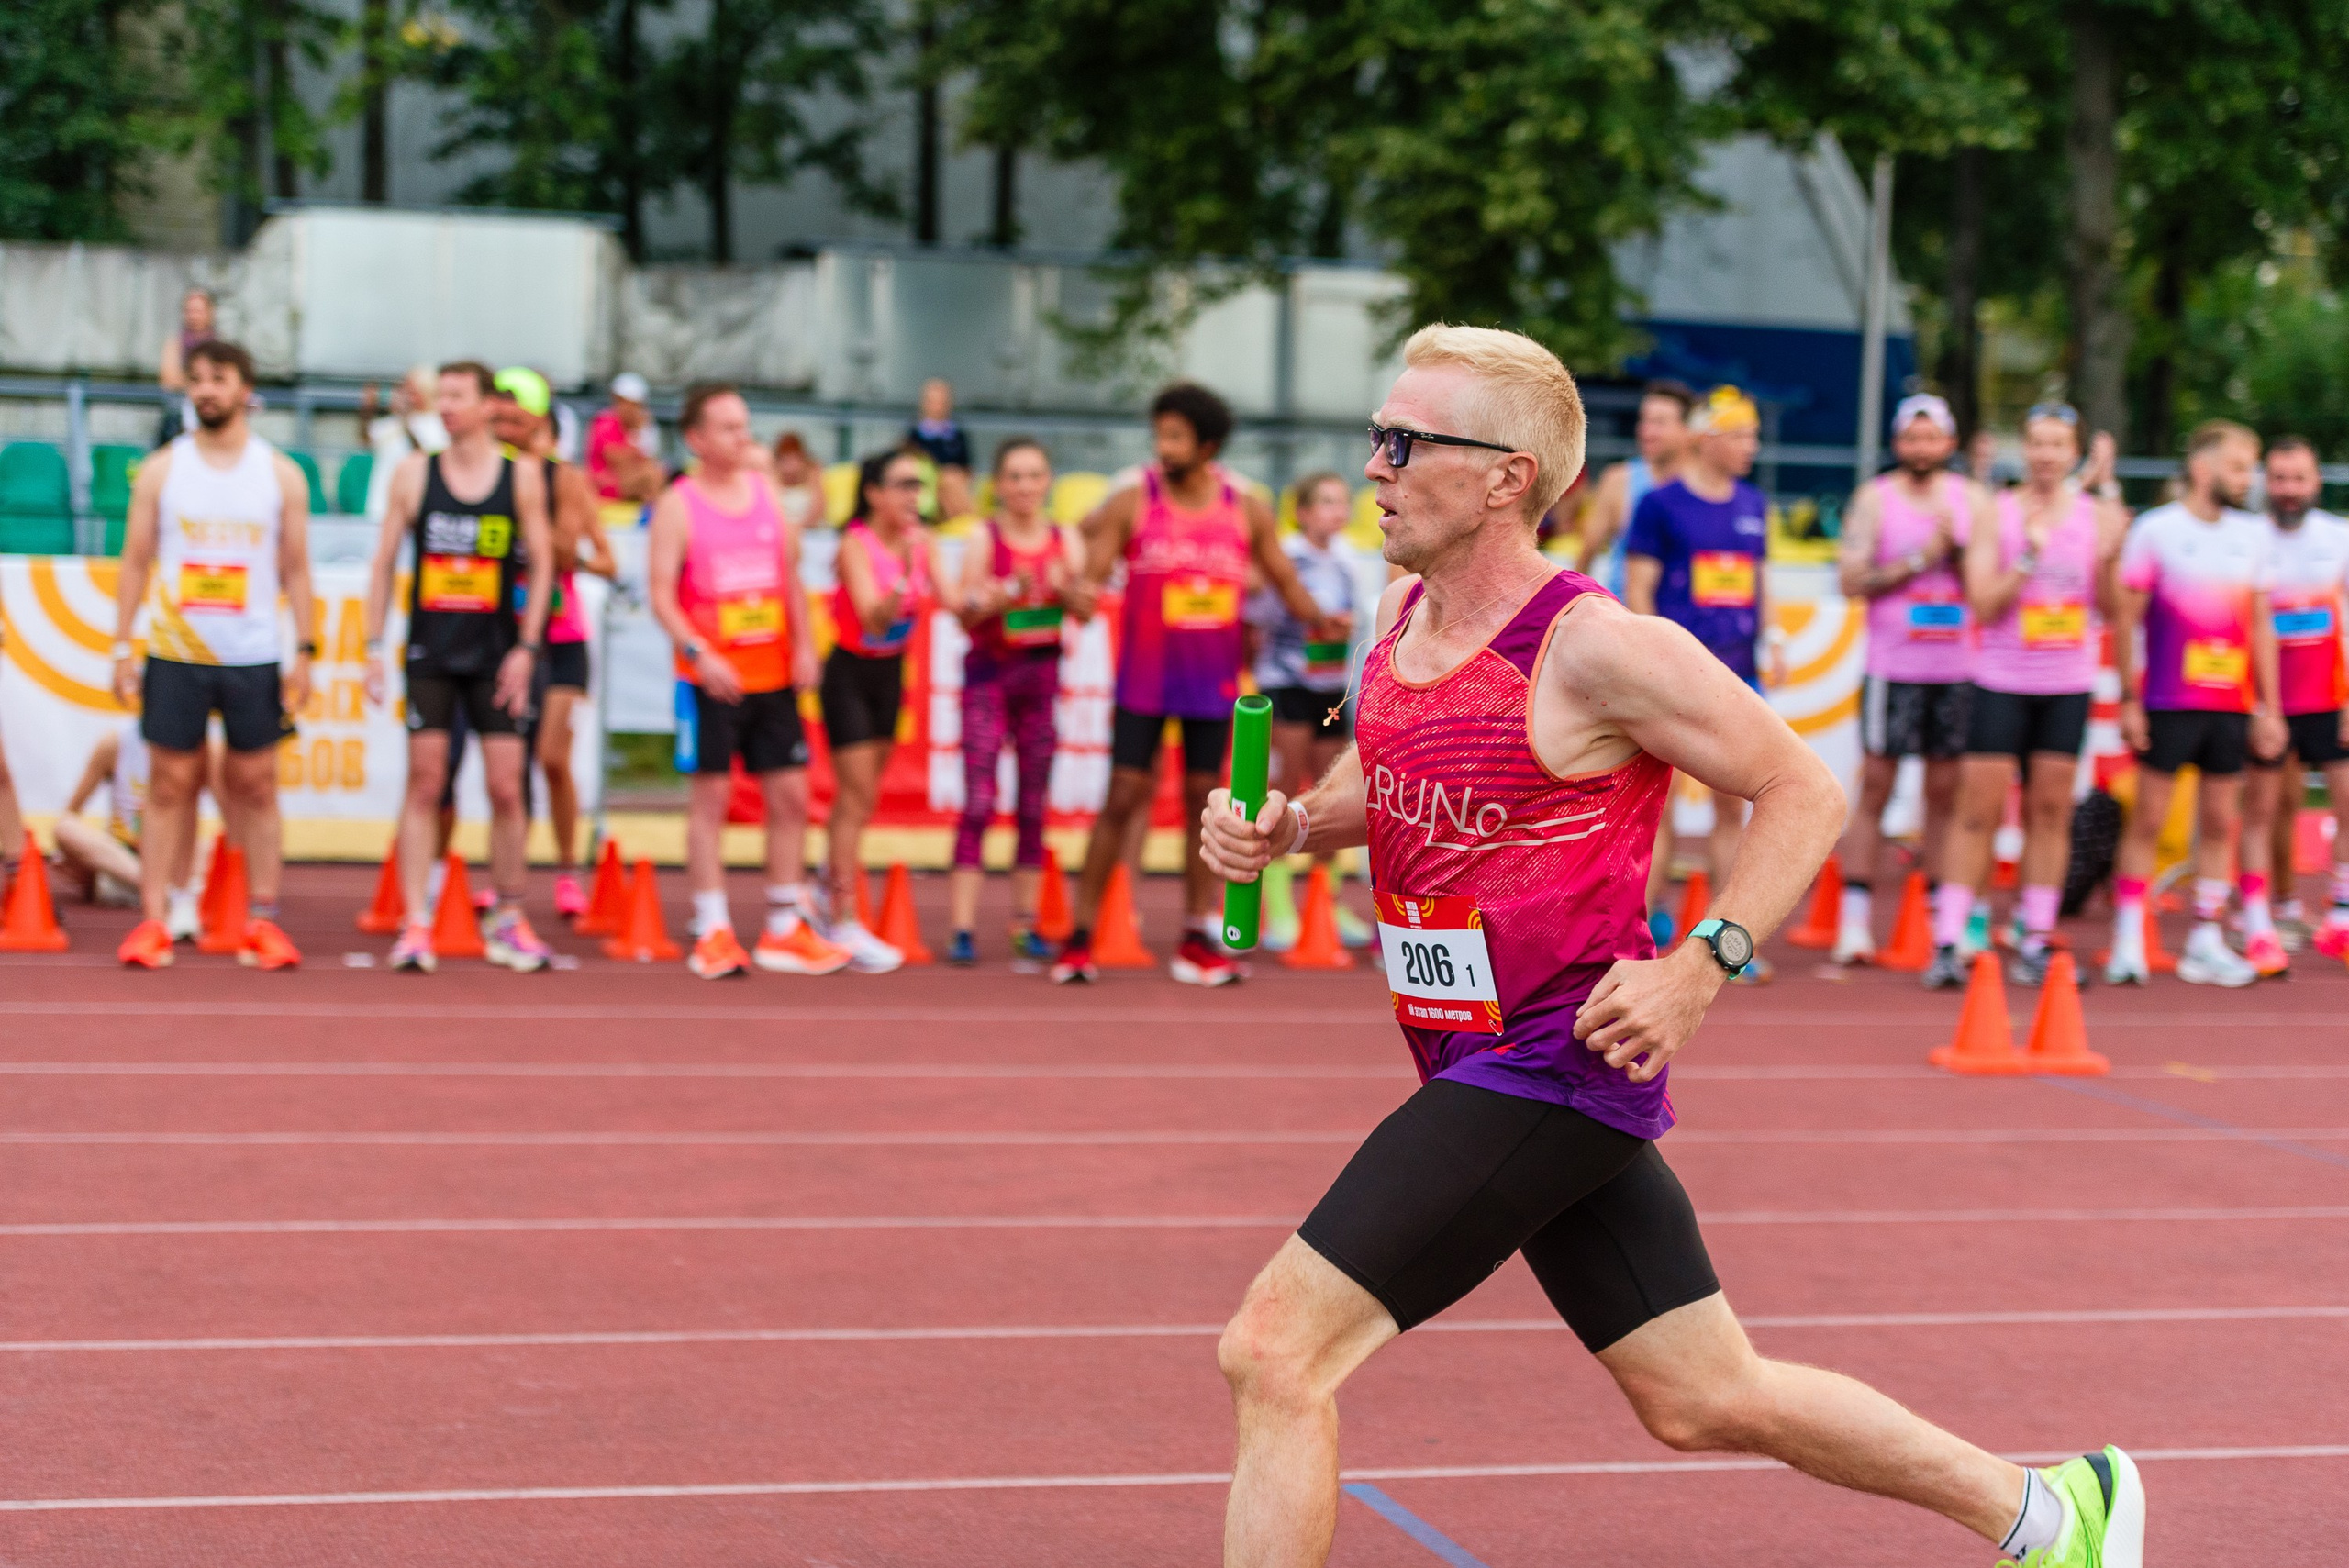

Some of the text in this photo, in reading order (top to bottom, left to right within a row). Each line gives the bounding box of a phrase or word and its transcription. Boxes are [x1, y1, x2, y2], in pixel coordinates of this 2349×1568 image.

[1401, 940, 1476, 988] 206 1
[1444, 1010, 1473, 1022] метров
